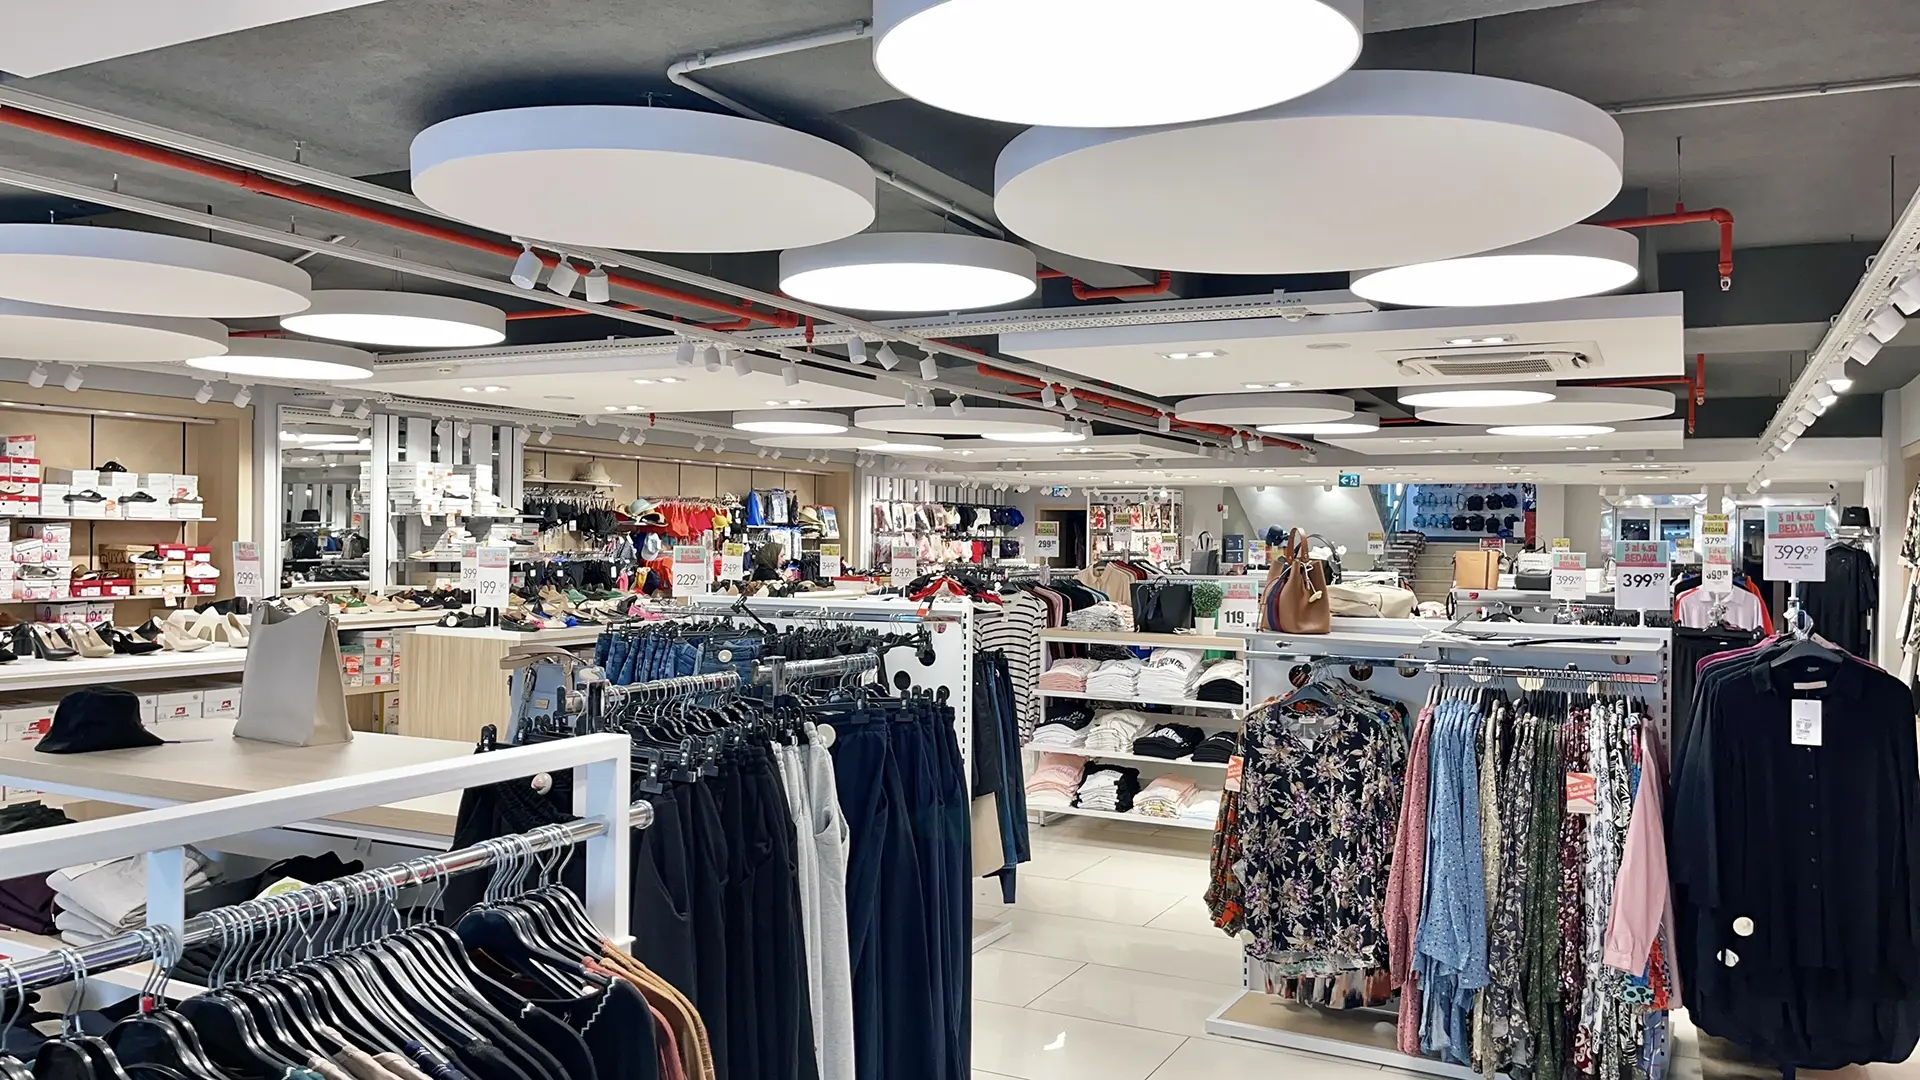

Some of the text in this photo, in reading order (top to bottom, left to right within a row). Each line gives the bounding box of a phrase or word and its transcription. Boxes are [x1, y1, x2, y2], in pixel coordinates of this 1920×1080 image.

[1777, 512, 1784, 522] 3
[1778, 523, 1815, 533] BEDAVA
[1625, 554, 1657, 563] BEDAVA
